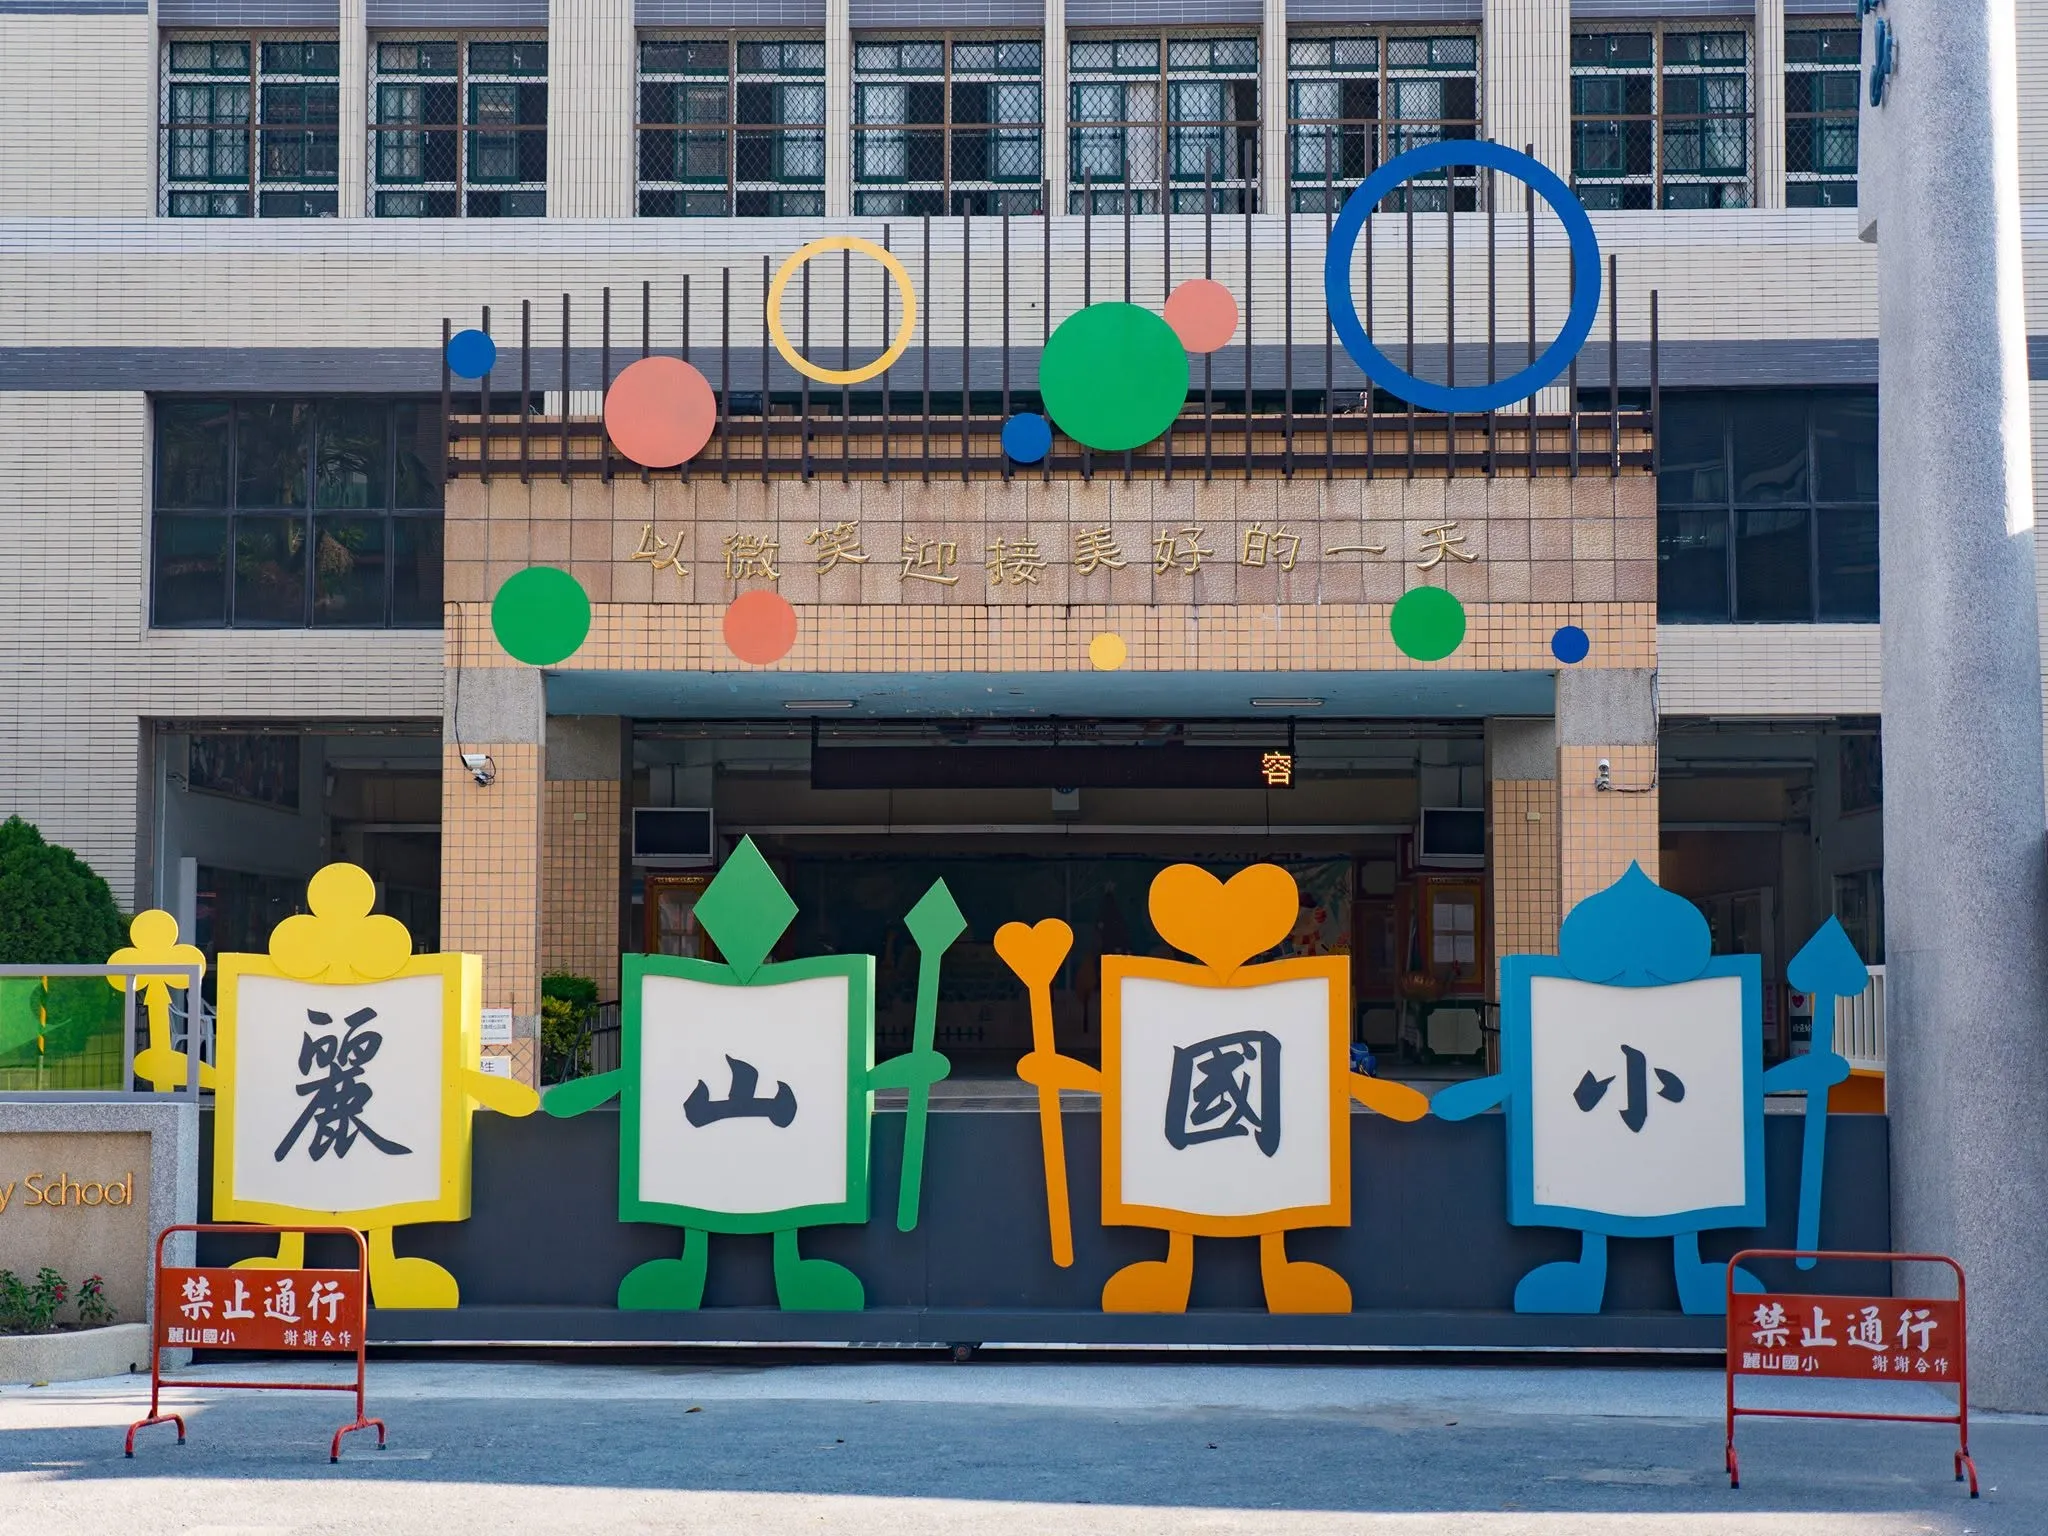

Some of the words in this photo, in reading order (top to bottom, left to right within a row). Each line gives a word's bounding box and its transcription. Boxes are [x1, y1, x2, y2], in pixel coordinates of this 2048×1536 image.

[632, 519, 1479, 586] 以微笑迎接美好的一天
[275, 1006, 412, 1163] 麗
[684, 1055, 797, 1129] 山
[1165, 1030, 1283, 1158] 國
[1573, 1044, 1686, 1133] 小
[24, 1171, 134, 1206] School
[180, 1276, 345, 1324] 禁止通行
[167, 1327, 236, 1345] 麗山國小
[283, 1329, 352, 1348] 謝謝合作
[1752, 1302, 1938, 1352] 禁止通行
[1742, 1352, 1819, 1372] 麗山國小
[1872, 1355, 1949, 1374] 謝謝合作
